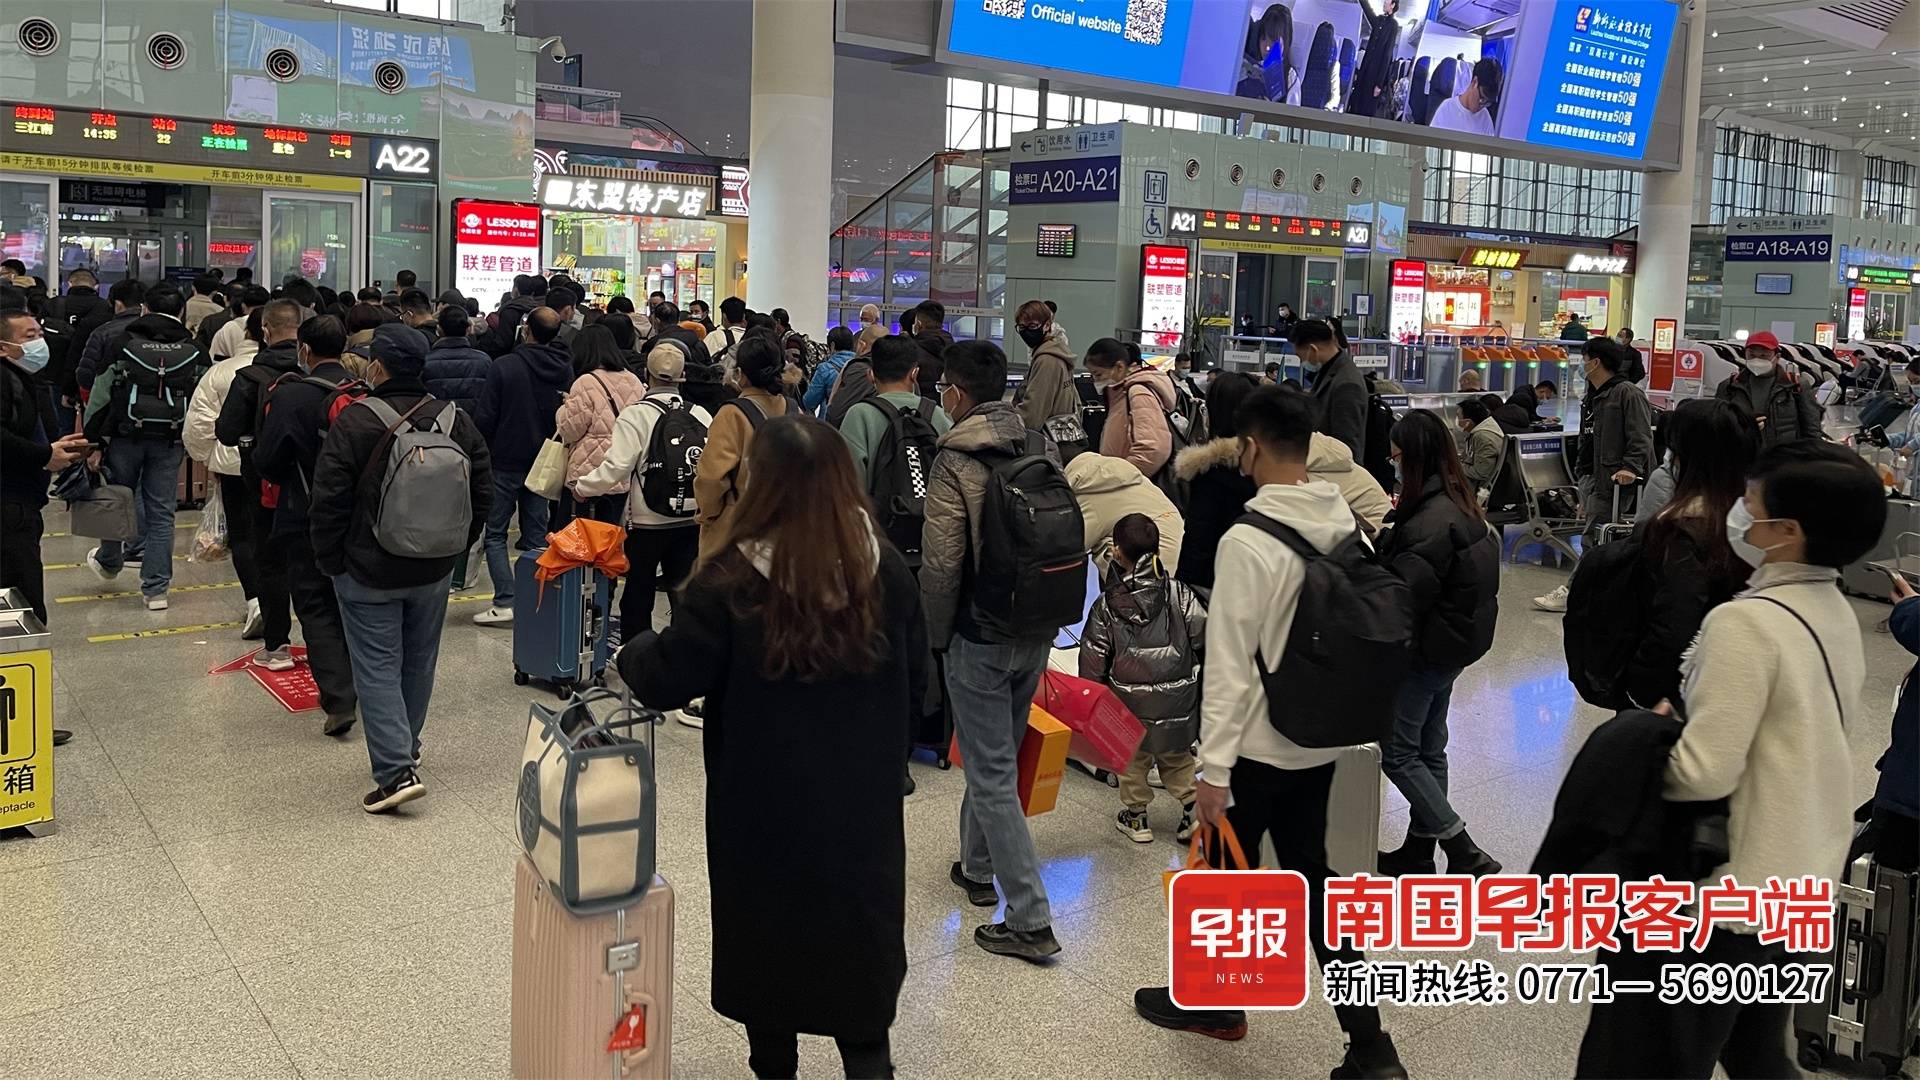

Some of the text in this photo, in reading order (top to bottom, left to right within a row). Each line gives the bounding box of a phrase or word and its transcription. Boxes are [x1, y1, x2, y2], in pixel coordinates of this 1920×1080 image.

[1031, 4, 1122, 34] Official website
[91, 112, 117, 126] 开点
[152, 118, 177, 131] 站台
[211, 123, 236, 136] 状态
[14, 121, 54, 136] 三江南
[83, 128, 118, 140] 14:35
[157, 133, 171, 144] 22
[201, 136, 248, 151] 正在检票
[1049, 130, 1115, 146] 饮用水 卫生间
[375, 143, 430, 174] A22
[211, 169, 303, 184] 开车前3分钟停止检票
[1015, 167, 1117, 193] 检票口 A20-A21
[570, 178, 707, 217] 东盟特产店
[1171, 211, 1196, 232] A21
[1347, 227, 1369, 244] A20
[1756, 240, 1829, 256] A18-A19
[462, 254, 533, 273] 联塑管道
[1147, 283, 1183, 296] 联塑管道
[3, 763, 37, 796] 箱
